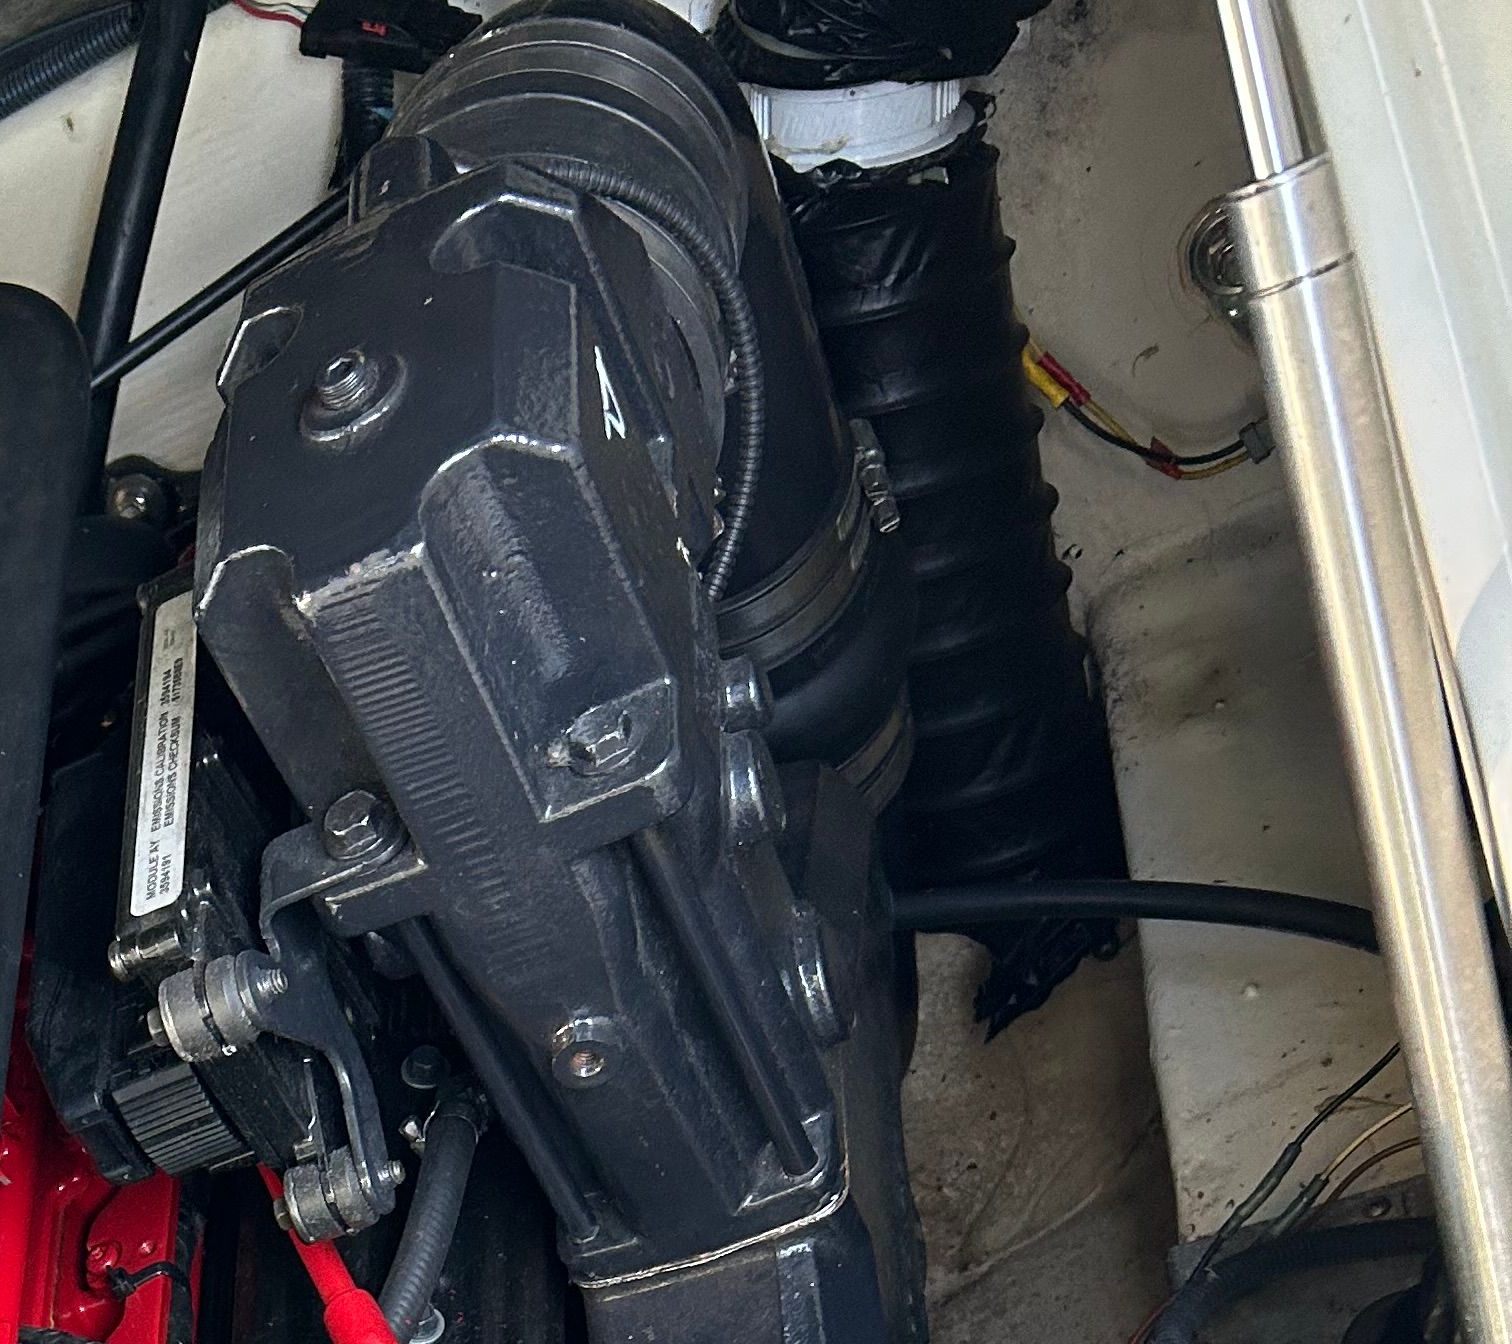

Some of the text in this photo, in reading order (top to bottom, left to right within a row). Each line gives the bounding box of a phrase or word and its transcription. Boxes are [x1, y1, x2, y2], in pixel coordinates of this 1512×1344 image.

[155, 711, 168, 776] CALIBRATION
[168, 716, 180, 770] CHECKSUM
[151, 777, 164, 832] EMISSIONS
[164, 772, 177, 828] EMISSIONS
[146, 855, 158, 900] MODULE
